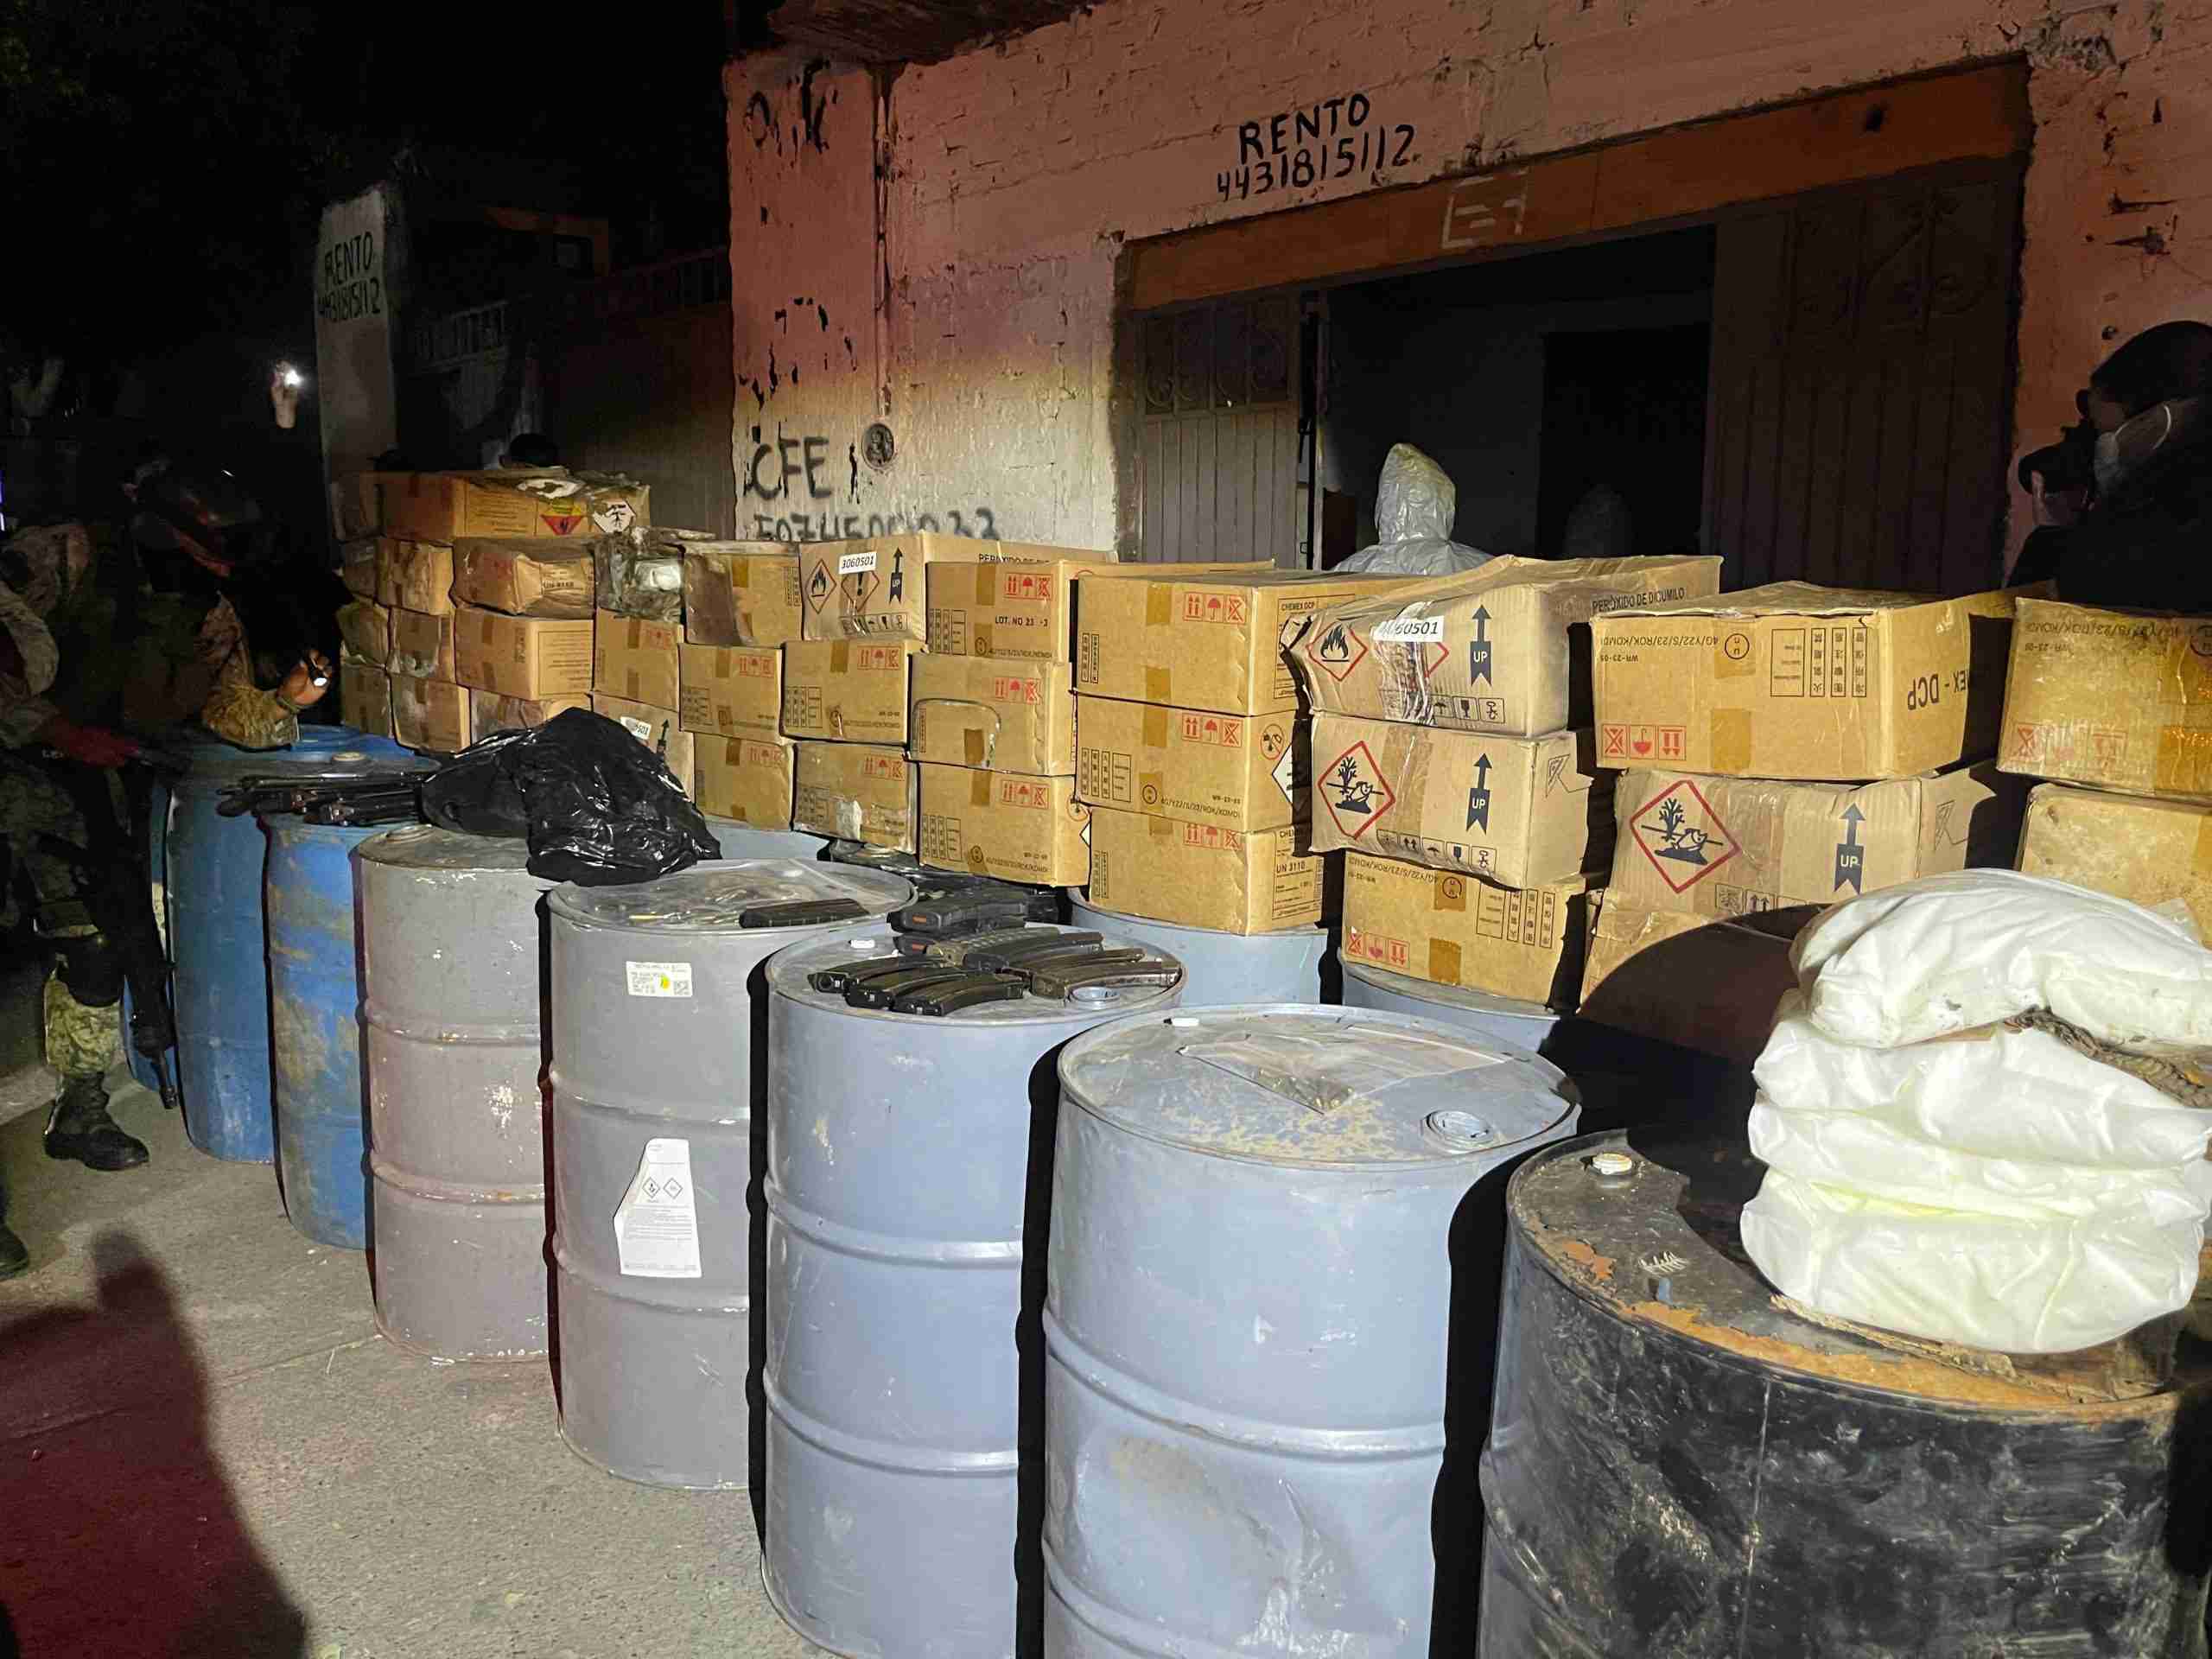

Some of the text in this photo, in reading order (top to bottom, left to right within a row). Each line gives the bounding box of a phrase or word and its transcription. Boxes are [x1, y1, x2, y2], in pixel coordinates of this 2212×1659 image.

[1239, 92, 1370, 165] RENTO
[1217, 124, 1416, 201] 4431815112
[324, 231, 373, 289] RENTO
[747, 435, 832, 499] CFE
[842, 555, 874, 569] 3060501
[1637, 593, 1647, 606] DE
[1473, 652, 1488, 663] UP
[1907, 673, 1939, 711] DCP
[1471, 798, 1486, 810] UP
[1840, 855, 1859, 868] UP
